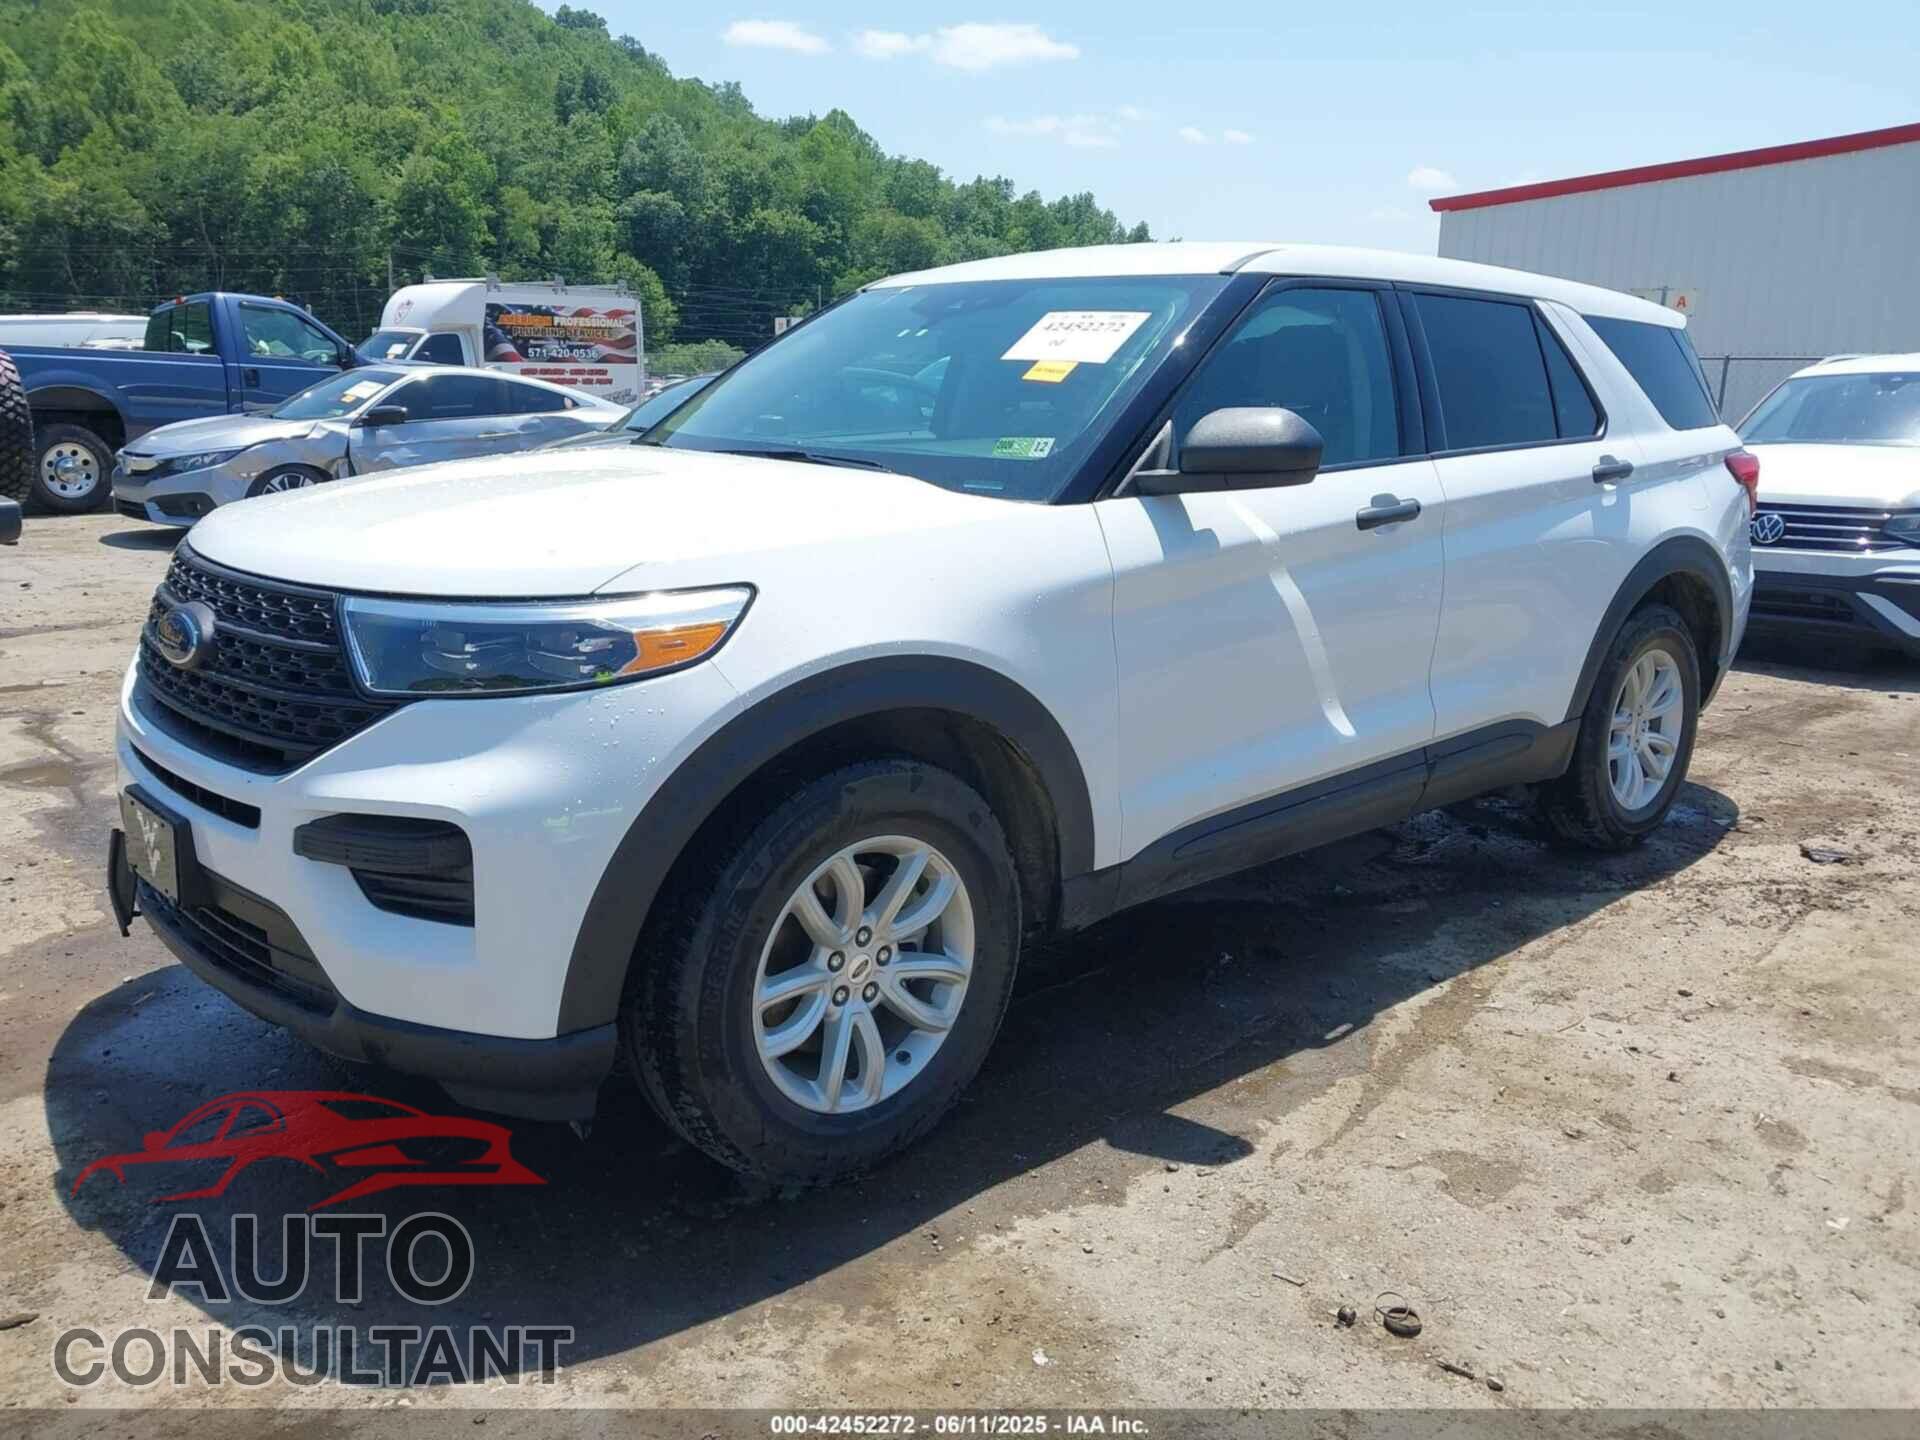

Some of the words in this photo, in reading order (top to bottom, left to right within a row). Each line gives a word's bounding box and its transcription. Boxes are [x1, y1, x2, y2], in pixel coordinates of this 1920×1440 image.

[1676, 296, 1687, 308] A
[553, 317, 625, 328] PROFESSIONAL
[1043, 320, 1127, 333] 42452272
[1034, 441, 1048, 453] 12
